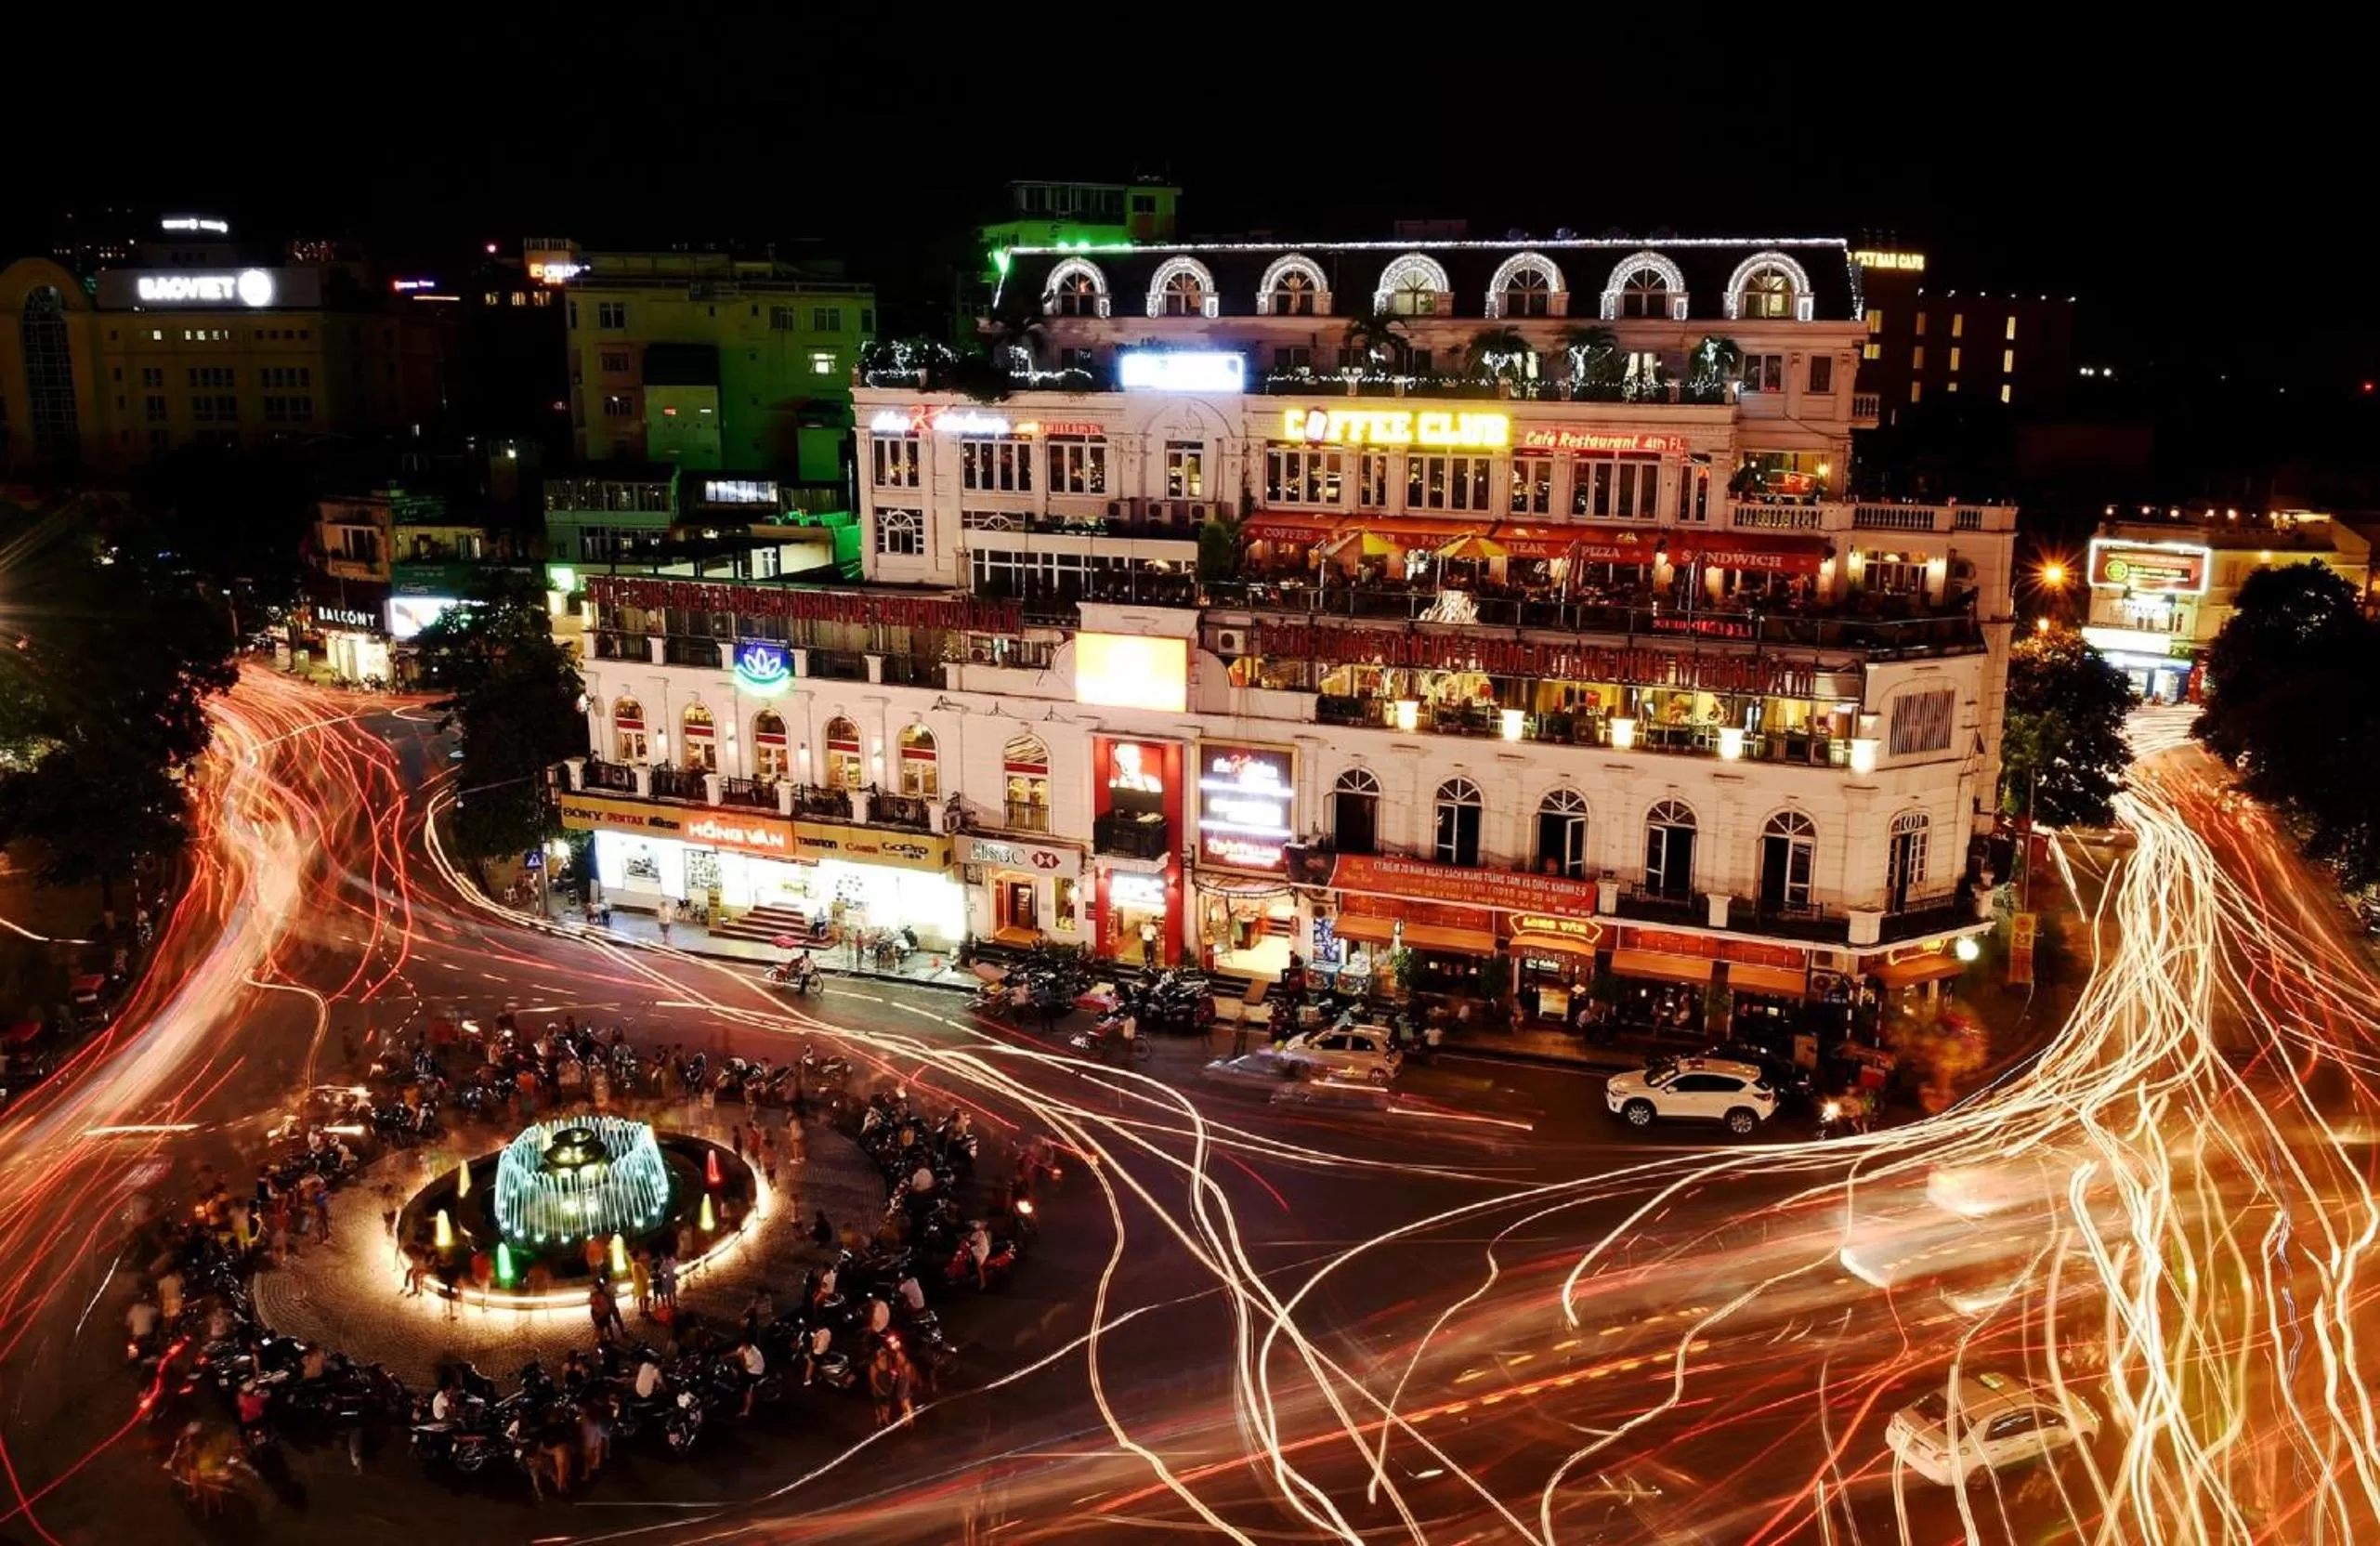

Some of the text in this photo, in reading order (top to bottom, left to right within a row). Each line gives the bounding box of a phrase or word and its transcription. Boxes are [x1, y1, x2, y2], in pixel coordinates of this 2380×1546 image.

[1285, 409, 1510, 447] COFFEE CLUB
[1559, 431, 1639, 451] Restaurant
[1263, 527, 1312, 541] COFFEE
[1581, 545, 1621, 557] PIZZA
[1681, 549, 1784, 569] SNDWICH
[318, 606, 375, 627] BALCONY
[563, 806, 603, 822] SONY
[607, 812, 645, 826] PENTAX
[648, 816, 681, 830] Nikon
[971, 840, 1026, 865] HSBC
